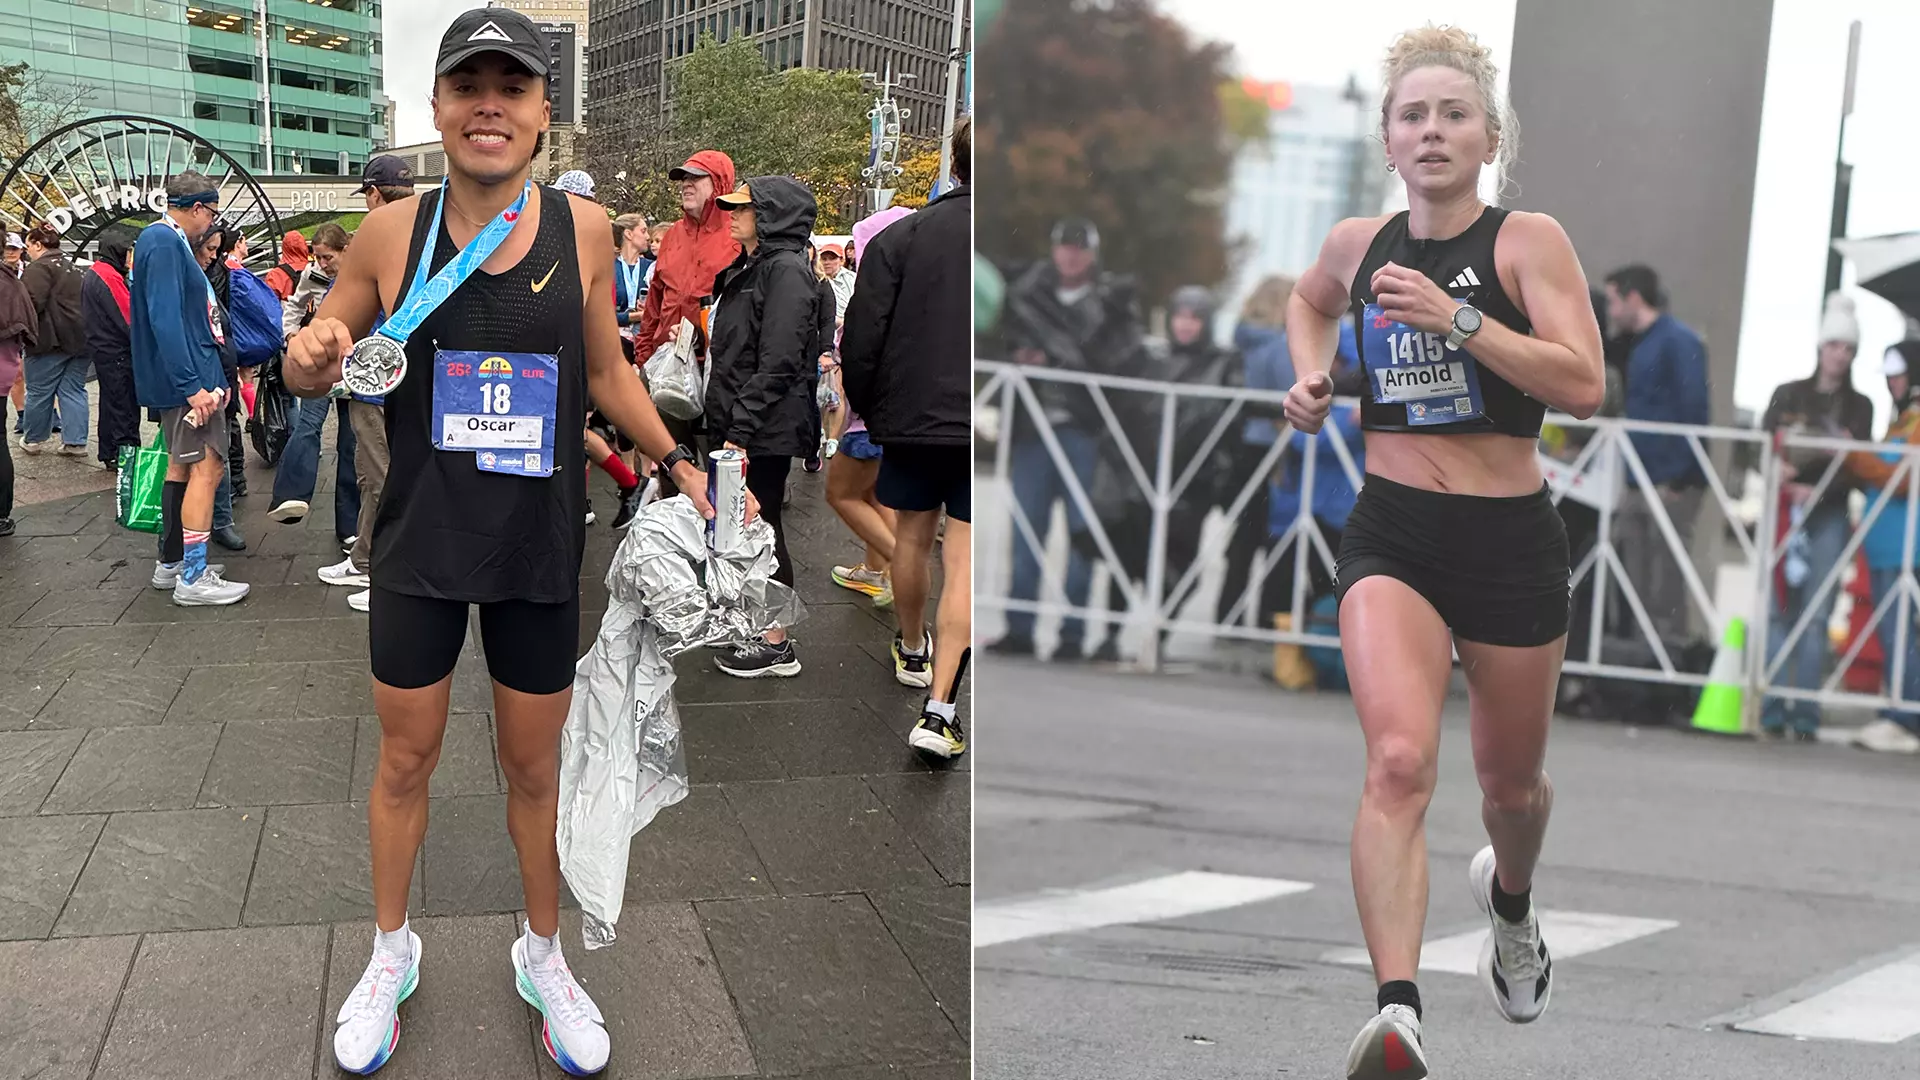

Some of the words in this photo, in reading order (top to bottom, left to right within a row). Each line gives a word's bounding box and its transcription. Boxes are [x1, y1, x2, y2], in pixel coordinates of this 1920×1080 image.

[1387, 332, 1444, 365] 1415
[344, 370, 384, 393] MARATHON
[521, 369, 546, 379] ELITE
[1385, 364, 1452, 387] Arnold
[479, 382, 511, 415] 18
[467, 417, 516, 432] Oscar
[446, 433, 455, 442] A
